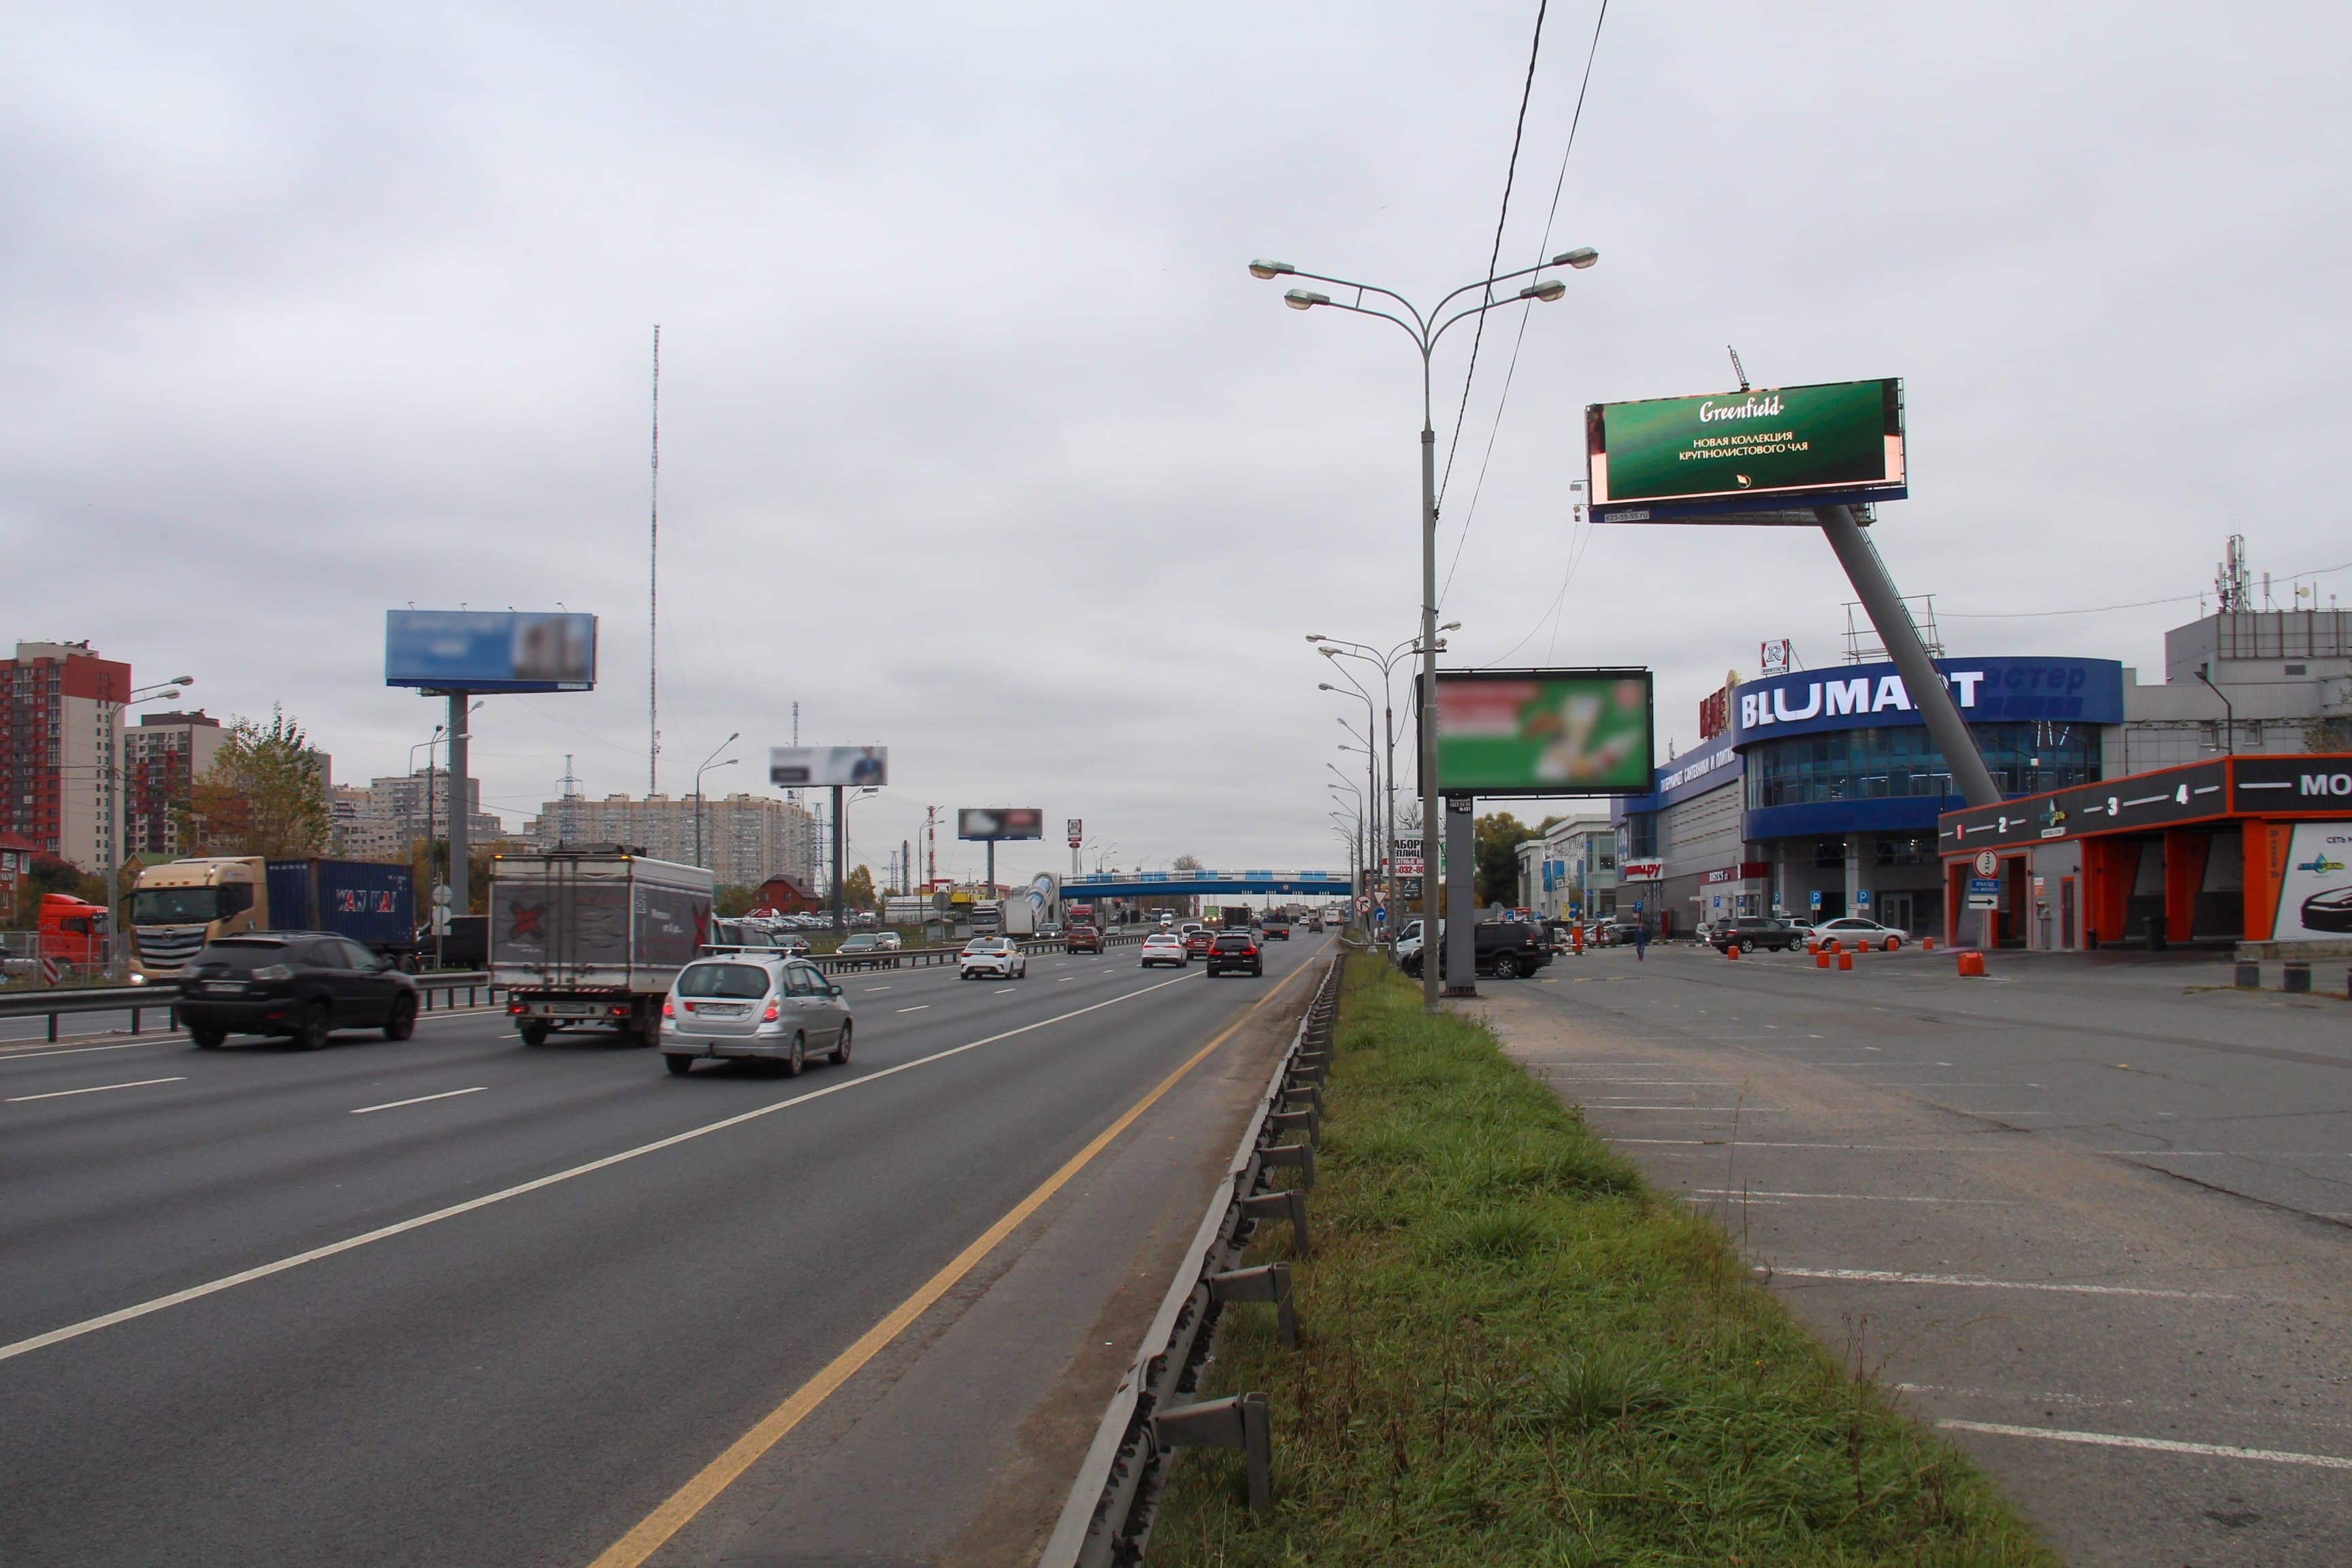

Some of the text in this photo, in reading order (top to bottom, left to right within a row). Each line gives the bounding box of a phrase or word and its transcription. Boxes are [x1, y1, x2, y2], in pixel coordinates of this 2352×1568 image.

[1700, 395, 1780, 423] Greenfield
[1693, 431, 1793, 448] НОВАЯ КОЛЛЕКЦИЯ
[1679, 442, 1808, 461] КРУПНОЛИСТОВОГО ЧАЯ
[1742, 672, 1984, 730] BLUMAT
[2176, 784, 2188, 804] 4
[2108, 797, 2118, 815] 3
[1957, 825, 1963, 840] 1
[1999, 817, 2007, 833] 2
[1985, 856, 1990, 865] 3
